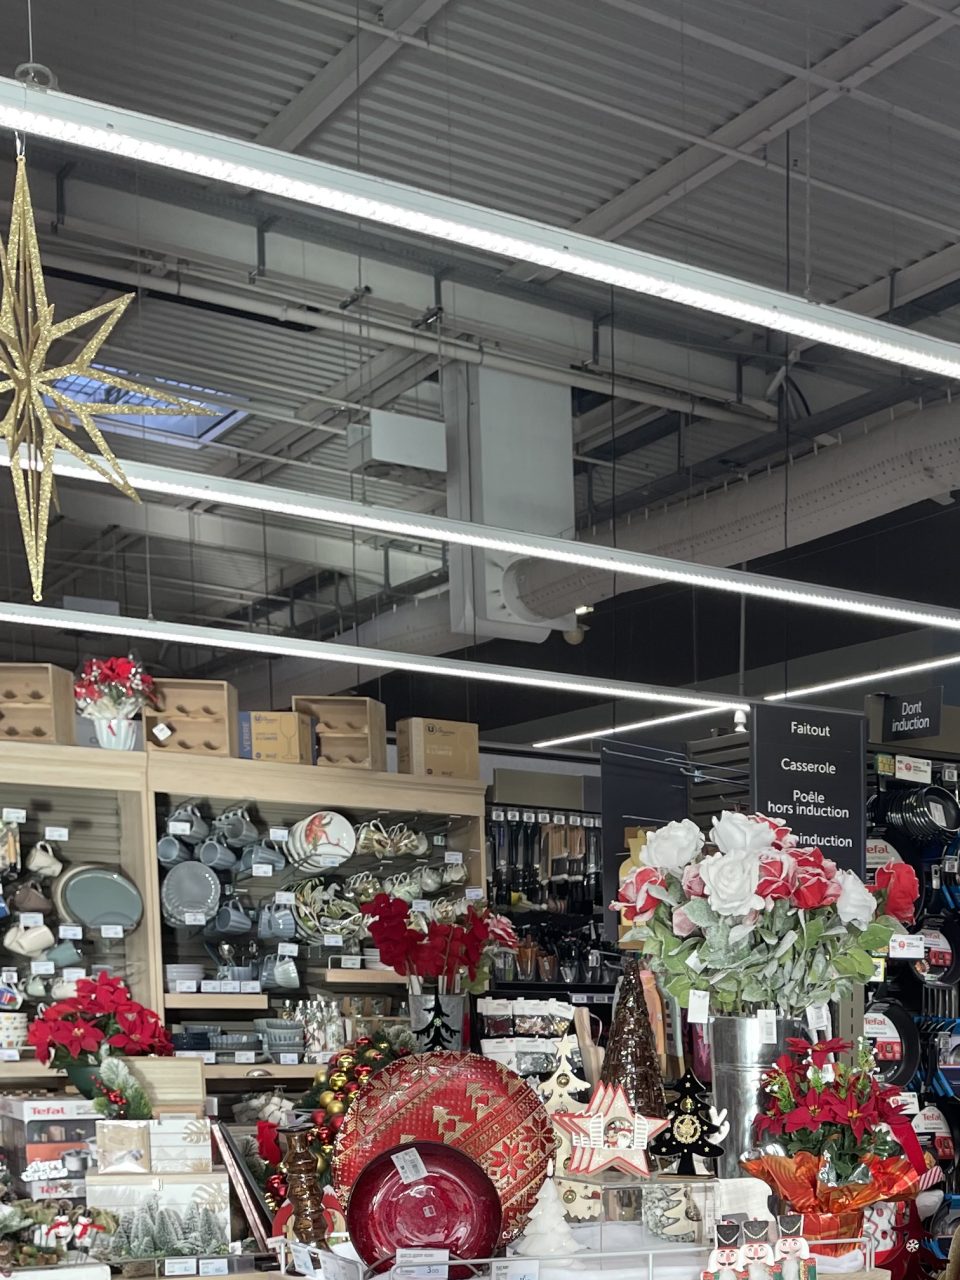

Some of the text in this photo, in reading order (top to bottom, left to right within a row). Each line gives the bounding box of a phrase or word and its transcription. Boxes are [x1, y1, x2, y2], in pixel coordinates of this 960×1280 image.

[902, 701, 922, 716] Dont
[791, 721, 830, 737] Faitout
[892, 716, 930, 732] induction
[781, 758, 836, 774] Casserole
[793, 789, 825, 803] Poêle
[768, 801, 849, 818] hors induction
[799, 832, 853, 847] induction
[866, 845, 889, 854] efal
[864, 1017, 887, 1026] Tefal
[31, 1107, 65, 1115] Tefal
[922, 1113, 941, 1121] Tefal
